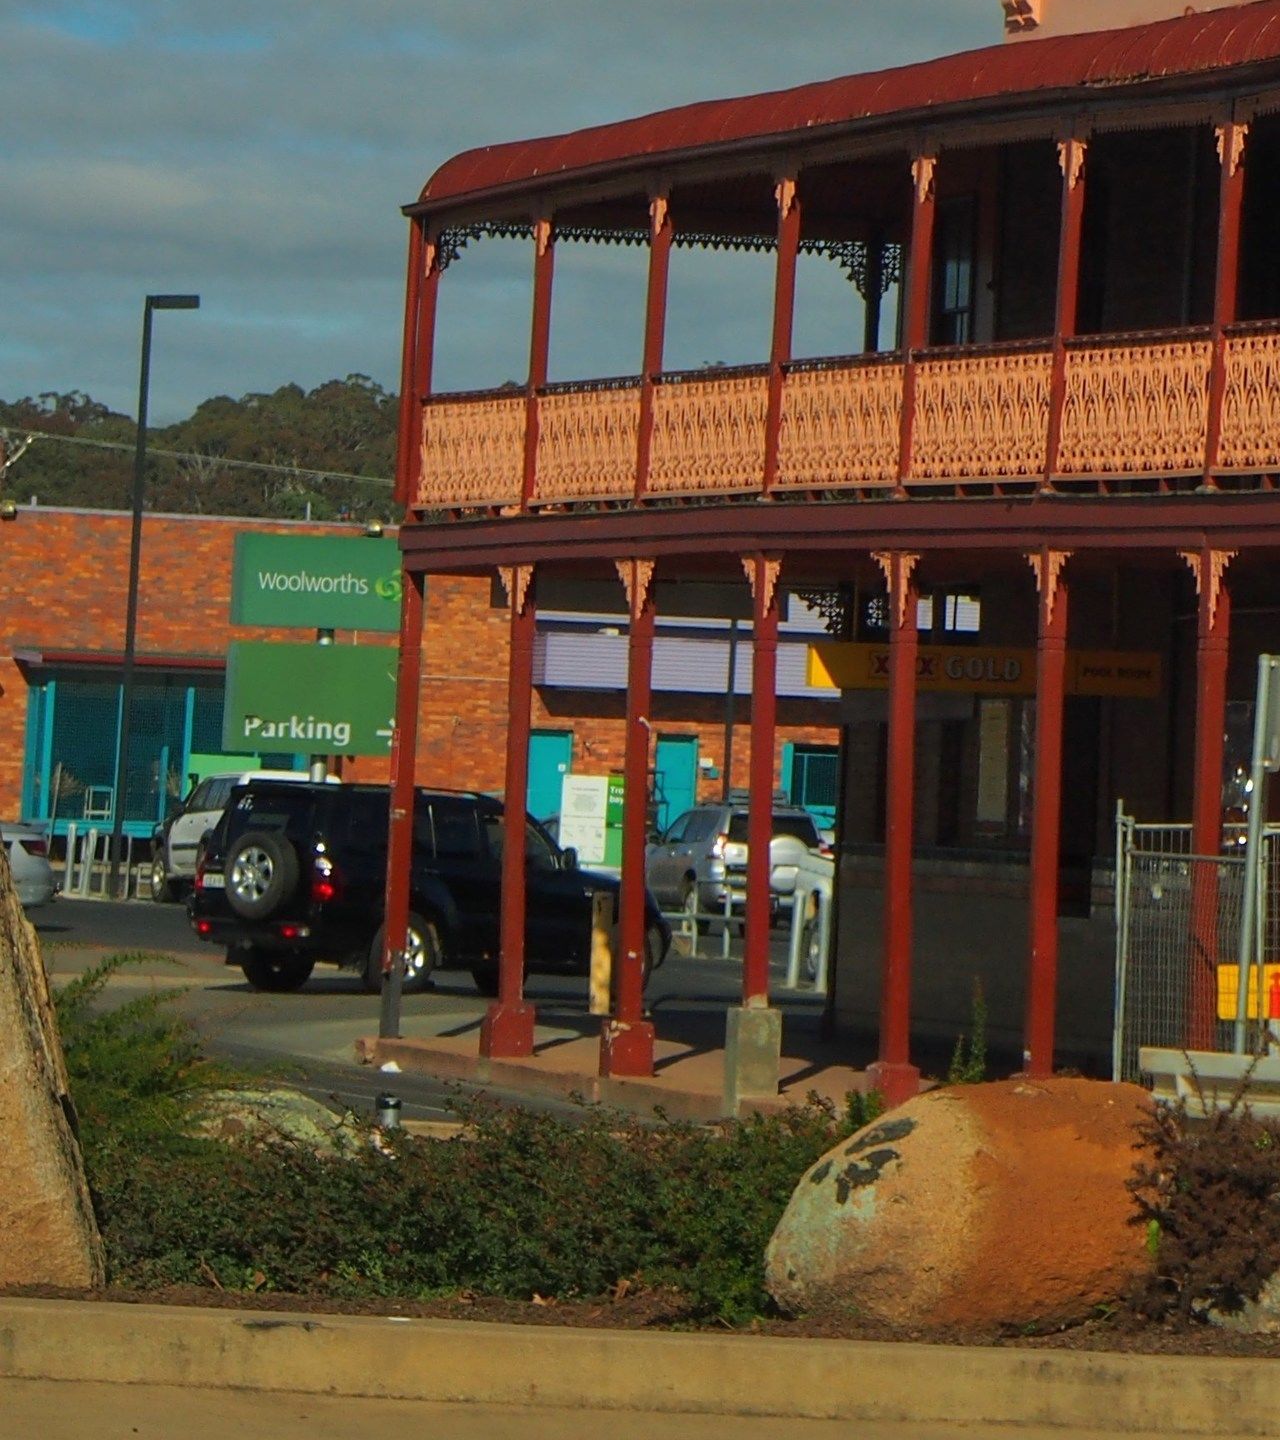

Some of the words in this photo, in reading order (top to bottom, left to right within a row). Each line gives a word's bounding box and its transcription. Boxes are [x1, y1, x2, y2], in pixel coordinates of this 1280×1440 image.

[258, 570, 369, 596] Woolworths
[943, 655, 1022, 681] GOLD
[243, 714, 351, 747] Parking
